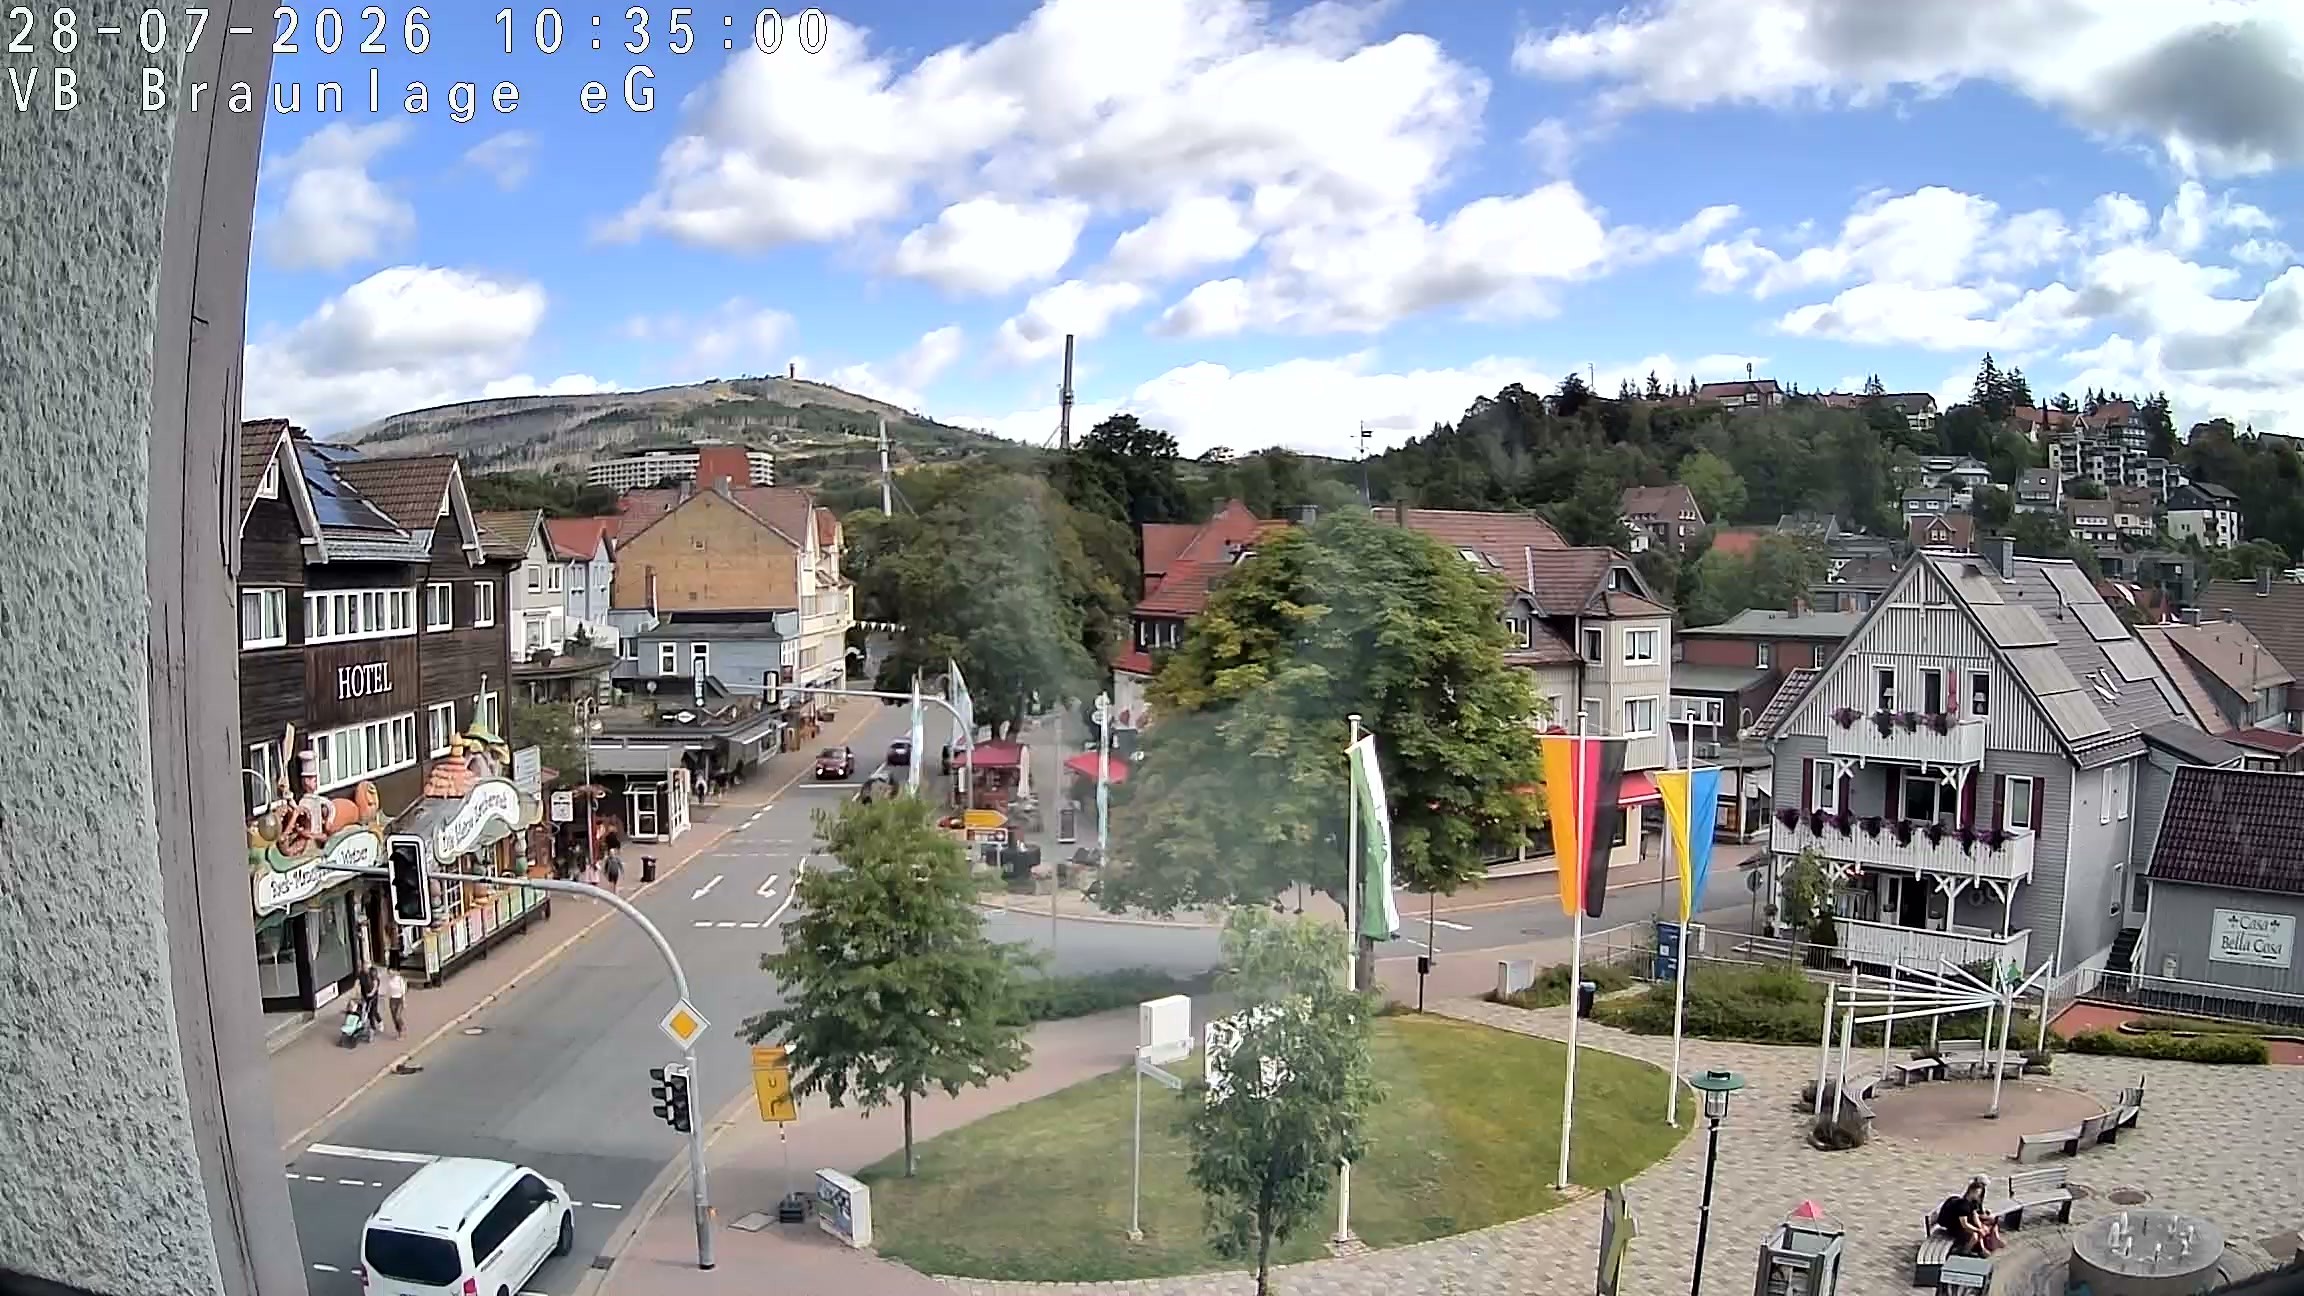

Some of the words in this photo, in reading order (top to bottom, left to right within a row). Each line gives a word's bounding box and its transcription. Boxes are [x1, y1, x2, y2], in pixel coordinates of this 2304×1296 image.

[337, 662, 393, 700] HOTEL
[2240, 915, 2268, 930] Casa
[2221, 930, 2250, 951] Bella
